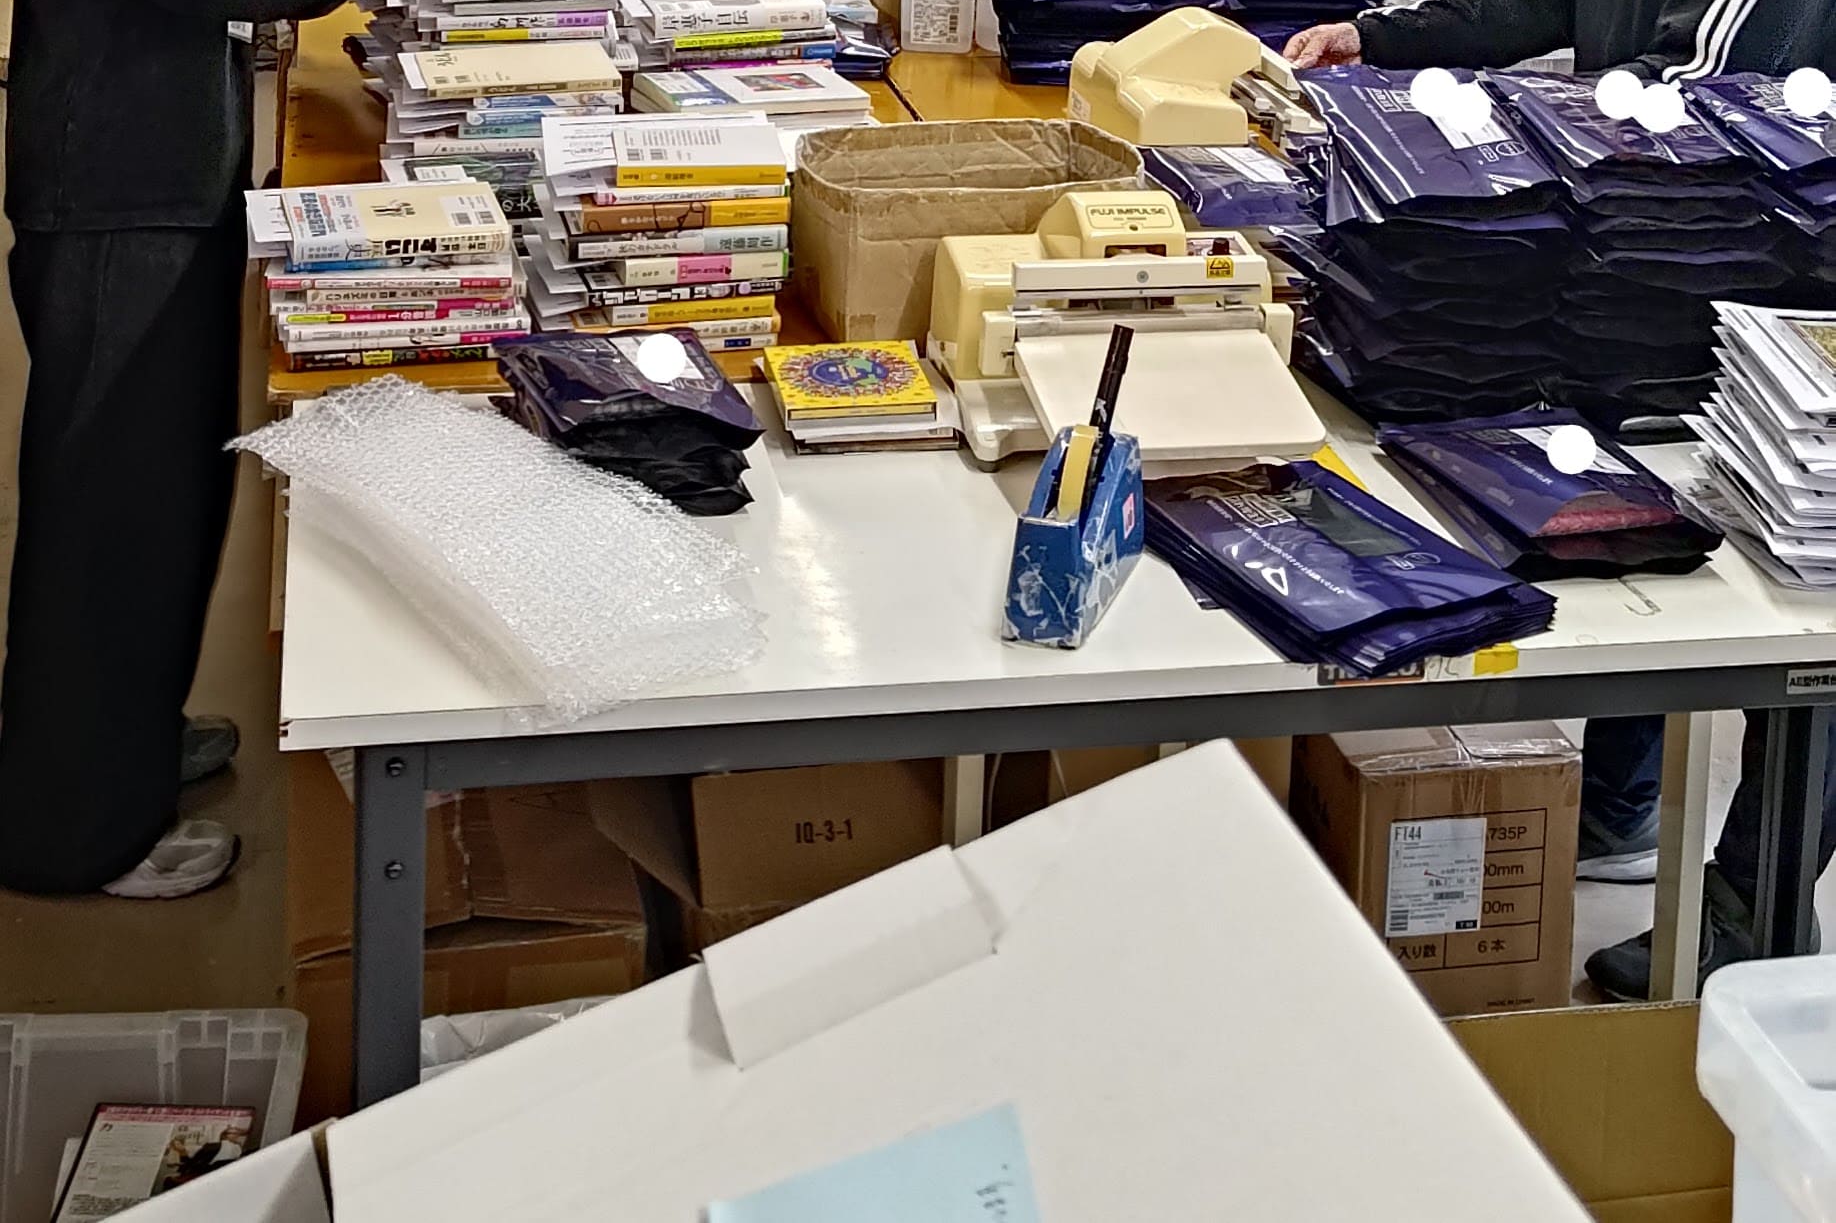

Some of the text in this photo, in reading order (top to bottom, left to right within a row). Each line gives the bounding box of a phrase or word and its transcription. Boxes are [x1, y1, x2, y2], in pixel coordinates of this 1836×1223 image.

[1090, 207, 1166, 216] FUJI IMPULSE
[795, 818, 853, 844] IQ-3-1
[1486, 826, 1527, 841] 735P
[1399, 944, 1437, 960] 入り数
